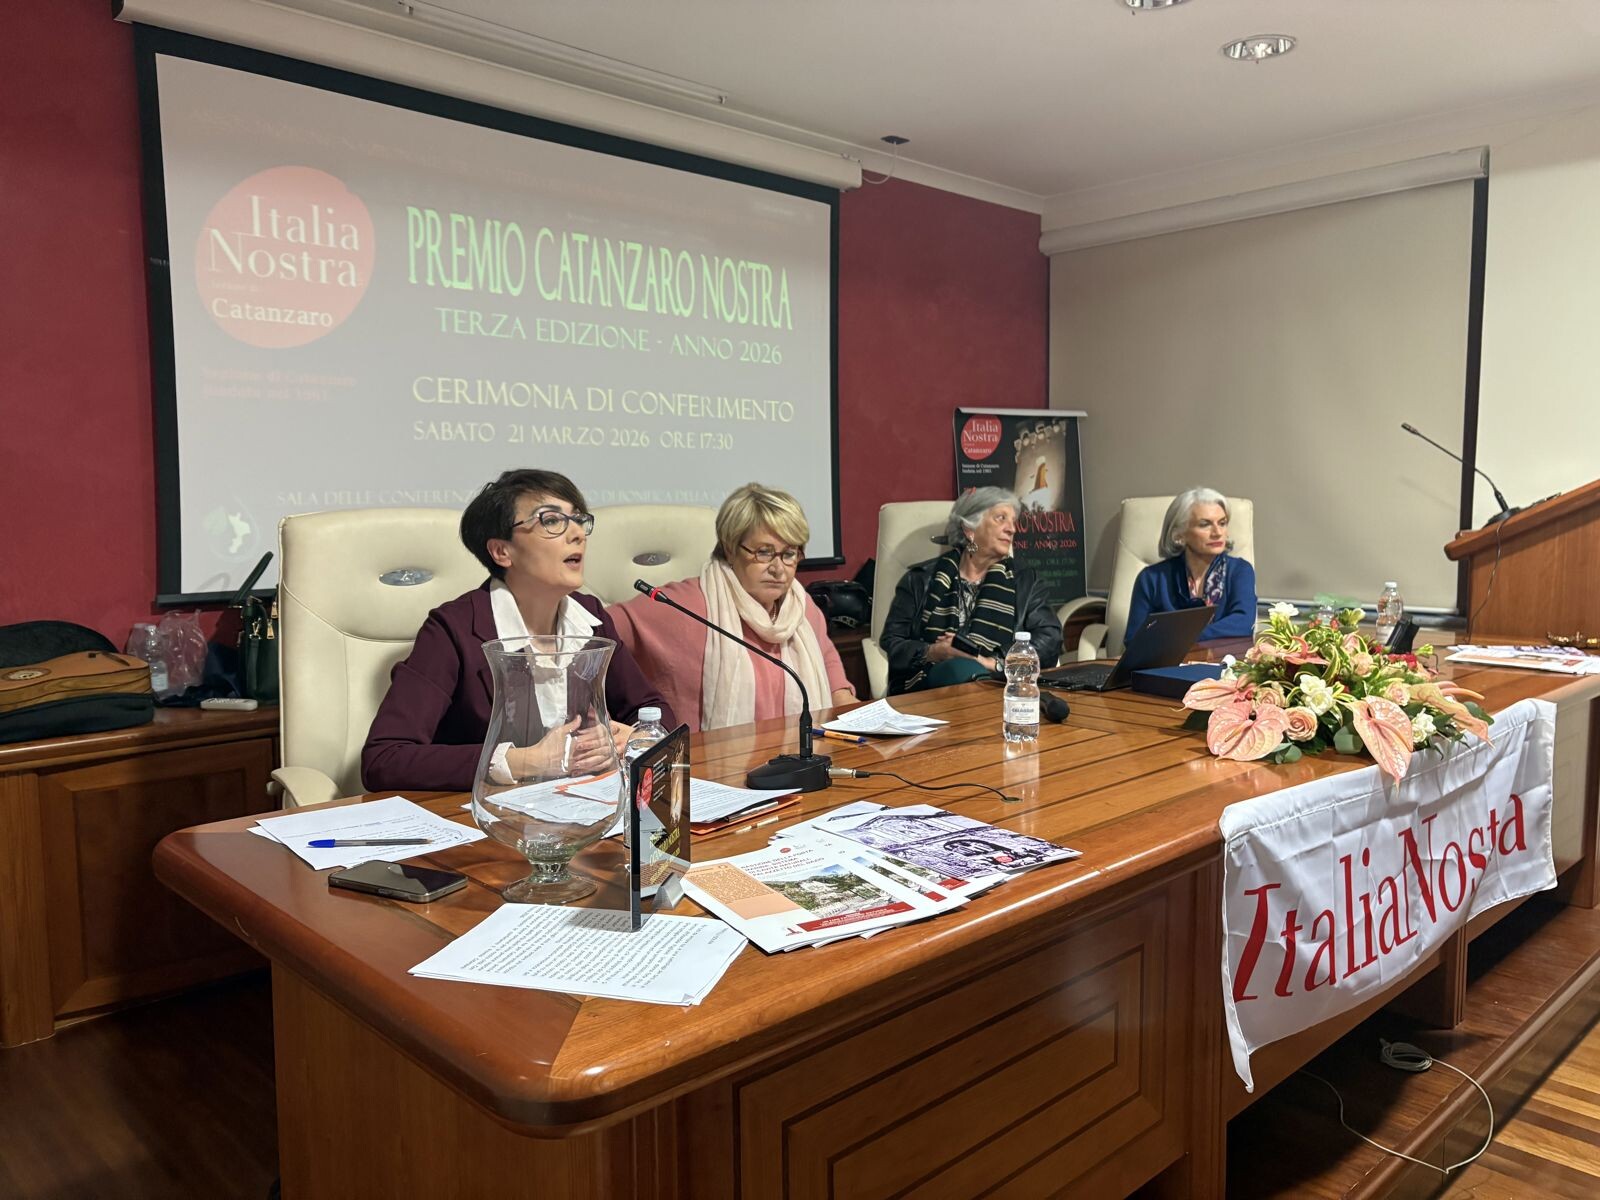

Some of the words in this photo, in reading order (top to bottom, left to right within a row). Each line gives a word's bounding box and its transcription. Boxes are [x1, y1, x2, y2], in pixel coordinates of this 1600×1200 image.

[247, 195, 360, 251] Italia
[202, 227, 359, 288] Nostra
[406, 205, 526, 296] PREMIO
[534, 227, 695, 318] CATANZARO
[701, 253, 792, 330] NOSTRA
[211, 297, 333, 328] Catanzaro
[434, 307, 527, 339] TERZA
[536, 318, 651, 352] EDIZIONE
[669, 333, 733, 360] ANNO
[739, 341, 783, 365] 2026
[412, 376, 579, 411] CERIMONIA
[586, 387, 614, 412] DI
[622, 391, 794, 423] CONFERIMENTO
[413, 421, 495, 443] SABATO
[507, 424, 524, 444] 21
[531, 425, 605, 447] MARZO
[610, 428, 650, 448] 2026
[660, 431, 696, 449] ORE
[700, 432, 734, 451] 17:30
[963, 430, 999, 442] Nostra
[972, 419, 998, 433] Italia
[277, 491, 319, 505] SALA
[324, 490, 373, 505] DELLE
[1032, 511, 1075, 533] NOSTRA
